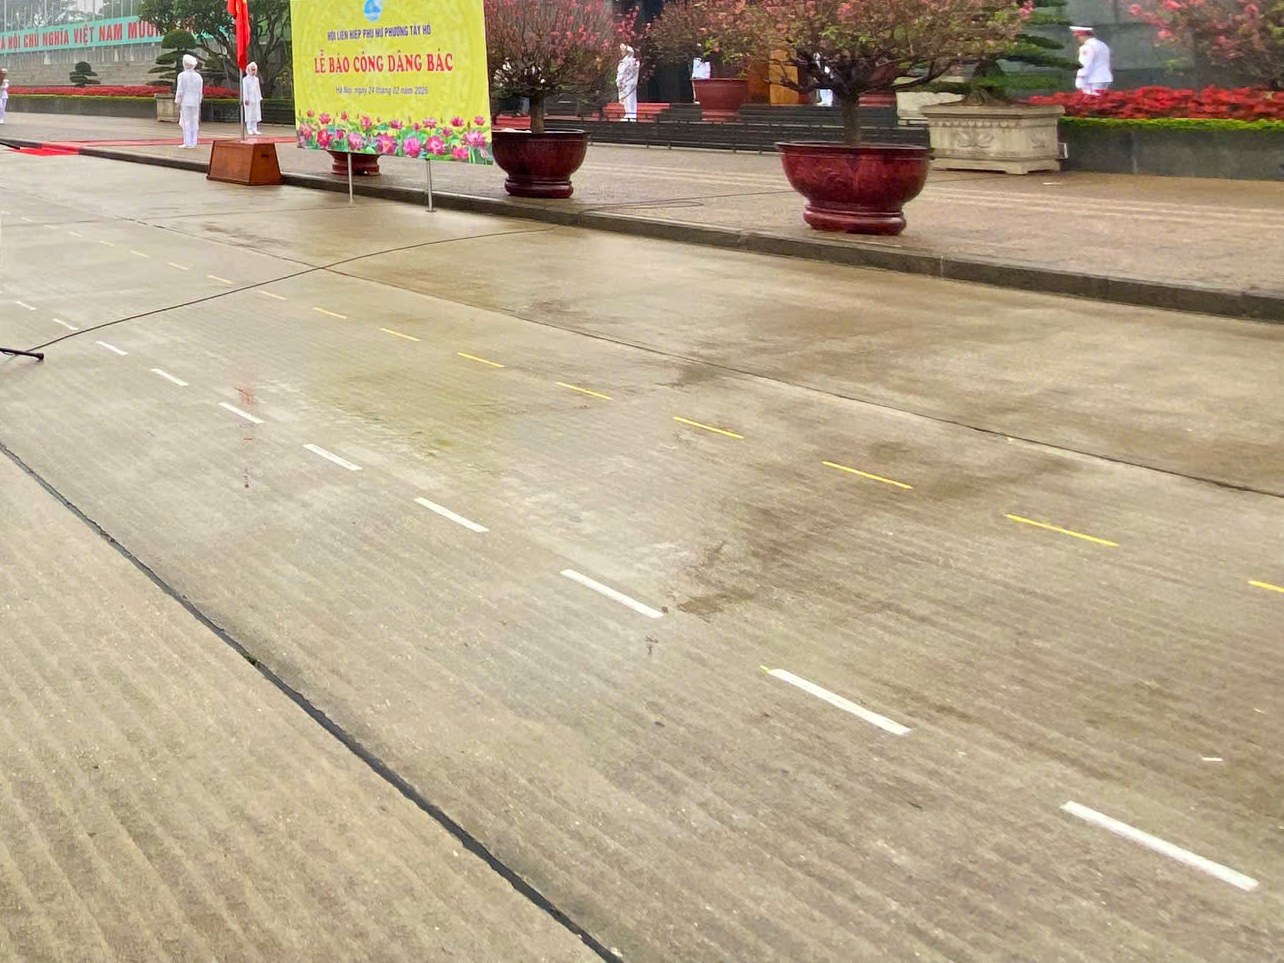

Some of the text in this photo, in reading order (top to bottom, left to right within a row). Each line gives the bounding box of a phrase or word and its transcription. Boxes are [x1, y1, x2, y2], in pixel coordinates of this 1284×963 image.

[73, 23, 95, 46] VIỆT
[99, 23, 123, 42] NAM
[314, 47, 453, 74] LỄ BÁO CÔNG DÂNG BÁC
